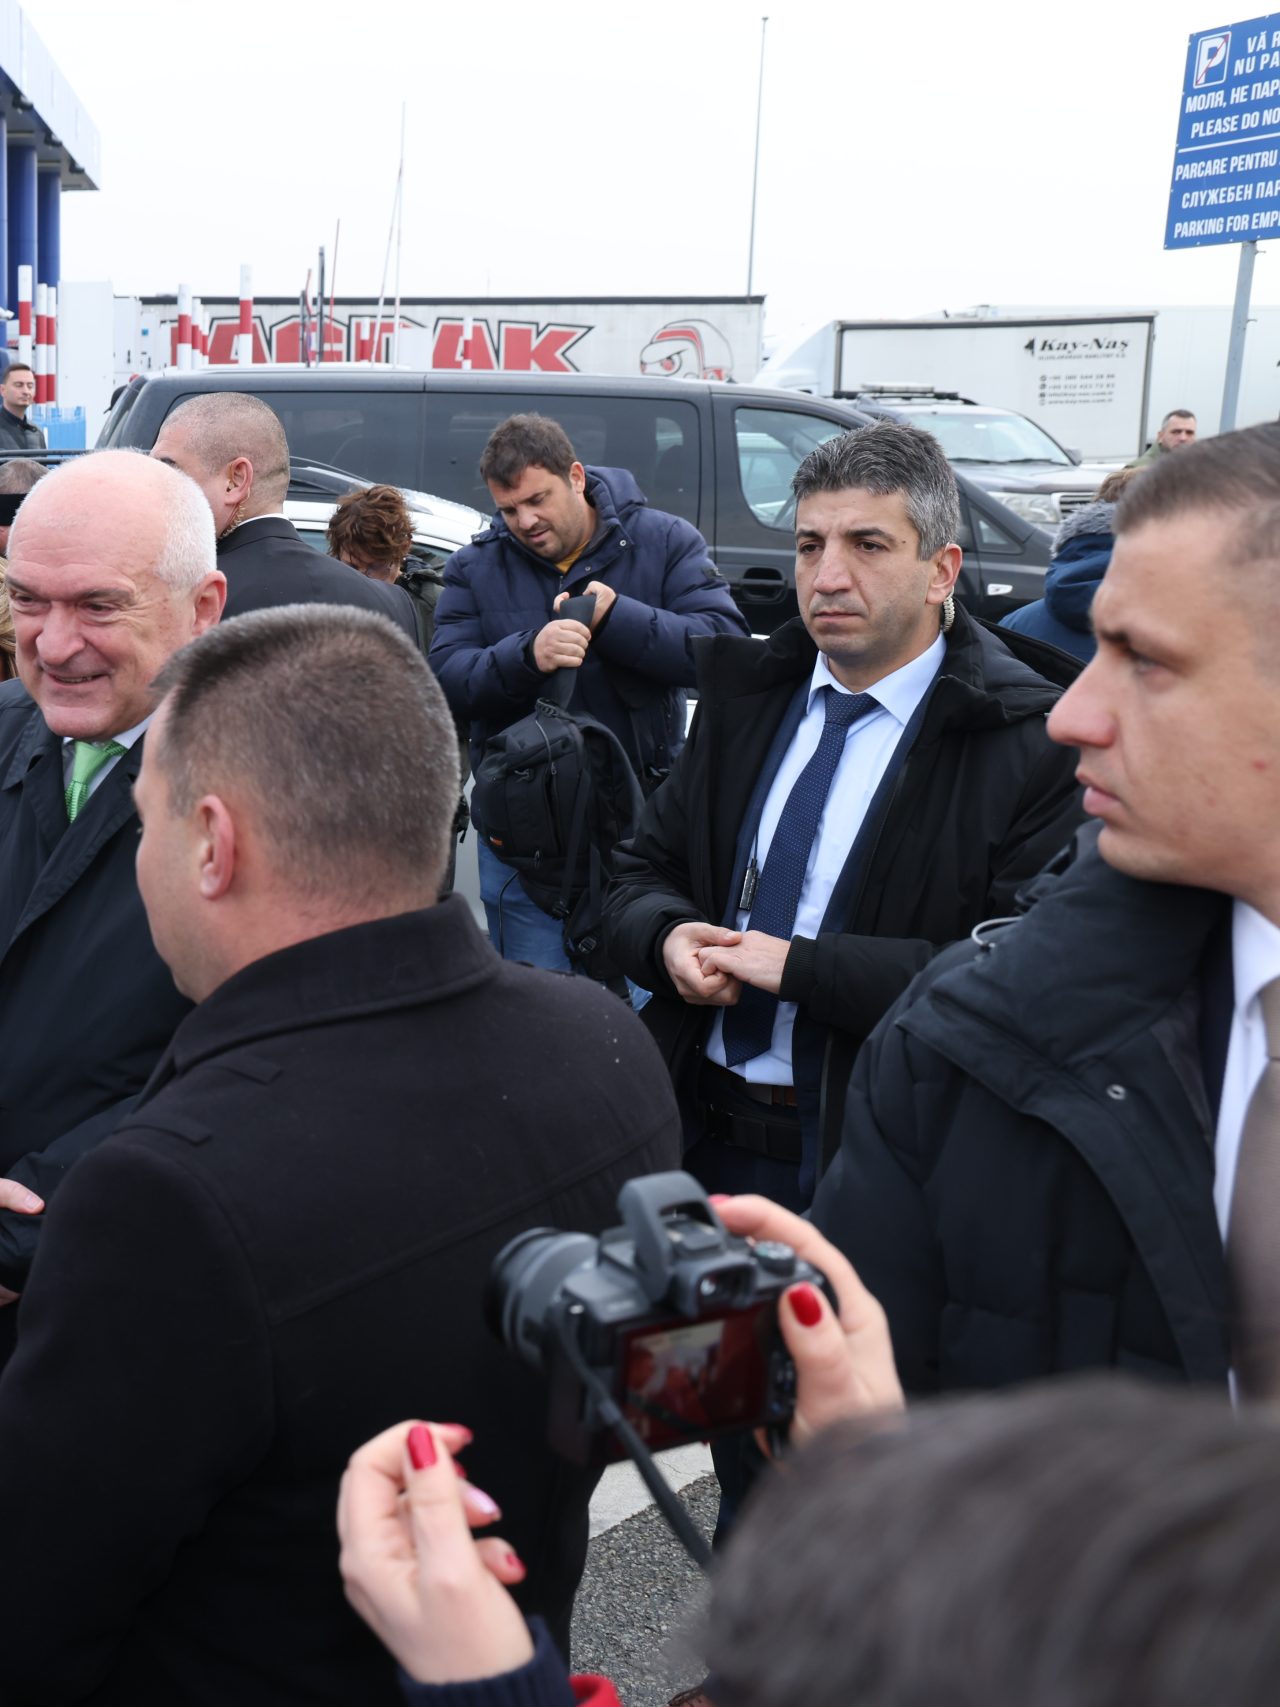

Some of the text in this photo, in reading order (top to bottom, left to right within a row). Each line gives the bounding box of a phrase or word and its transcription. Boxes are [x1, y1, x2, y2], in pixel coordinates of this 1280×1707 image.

[1233, 56, 1256, 76] NU
[1185, 78, 1280, 114] МОЛЯ, НЕ ПАР
[1190, 114, 1240, 139] PLEASE
[1240, 110, 1260, 130] DO
[1175, 149, 1278, 181] PARCARE PENTRU
[1181, 184, 1254, 209] СЛУЖЕБЕН
[1173, 210, 1280, 239] PARKING FOR EMP
